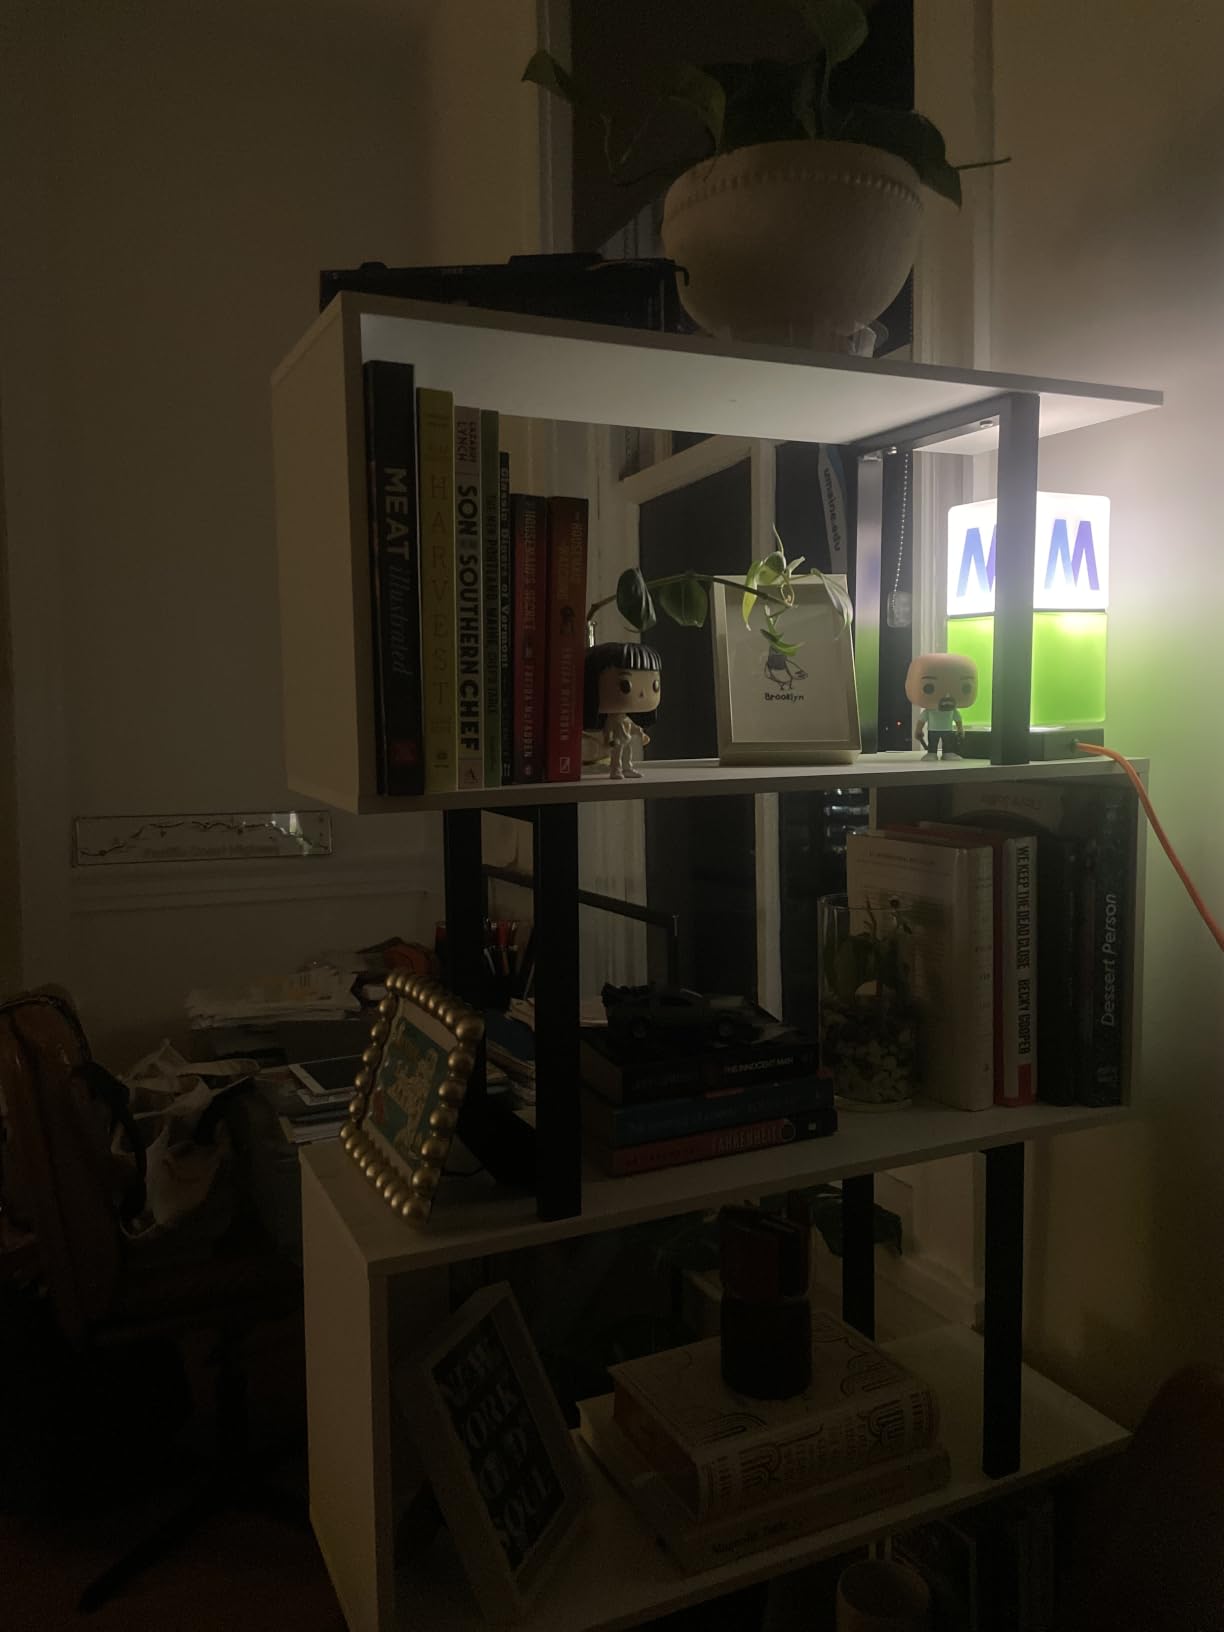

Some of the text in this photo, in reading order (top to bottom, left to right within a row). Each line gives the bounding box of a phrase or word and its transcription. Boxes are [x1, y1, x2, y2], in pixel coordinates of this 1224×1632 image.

[457, 421, 468, 462] LYNCH
[384, 467, 411, 561] MEAT
[458, 485, 478, 536] SON
[499, 528, 509, 577] Diners
[431, 473, 450, 705] HARVEST
[458, 554, 479, 674] SOUTHERN
[499, 583, 509, 599] of
[500, 606, 510, 669] Vermont
[459, 679, 480, 751] CHEF
[764, 692, 804, 704] Brooklyn
[1016, 846, 1031, 969] WE KEEP THE DEAD CLOSE
[1100, 893, 1118, 1027] Dessert Person
[1017, 979, 1031, 1055] BECKY COOPER
